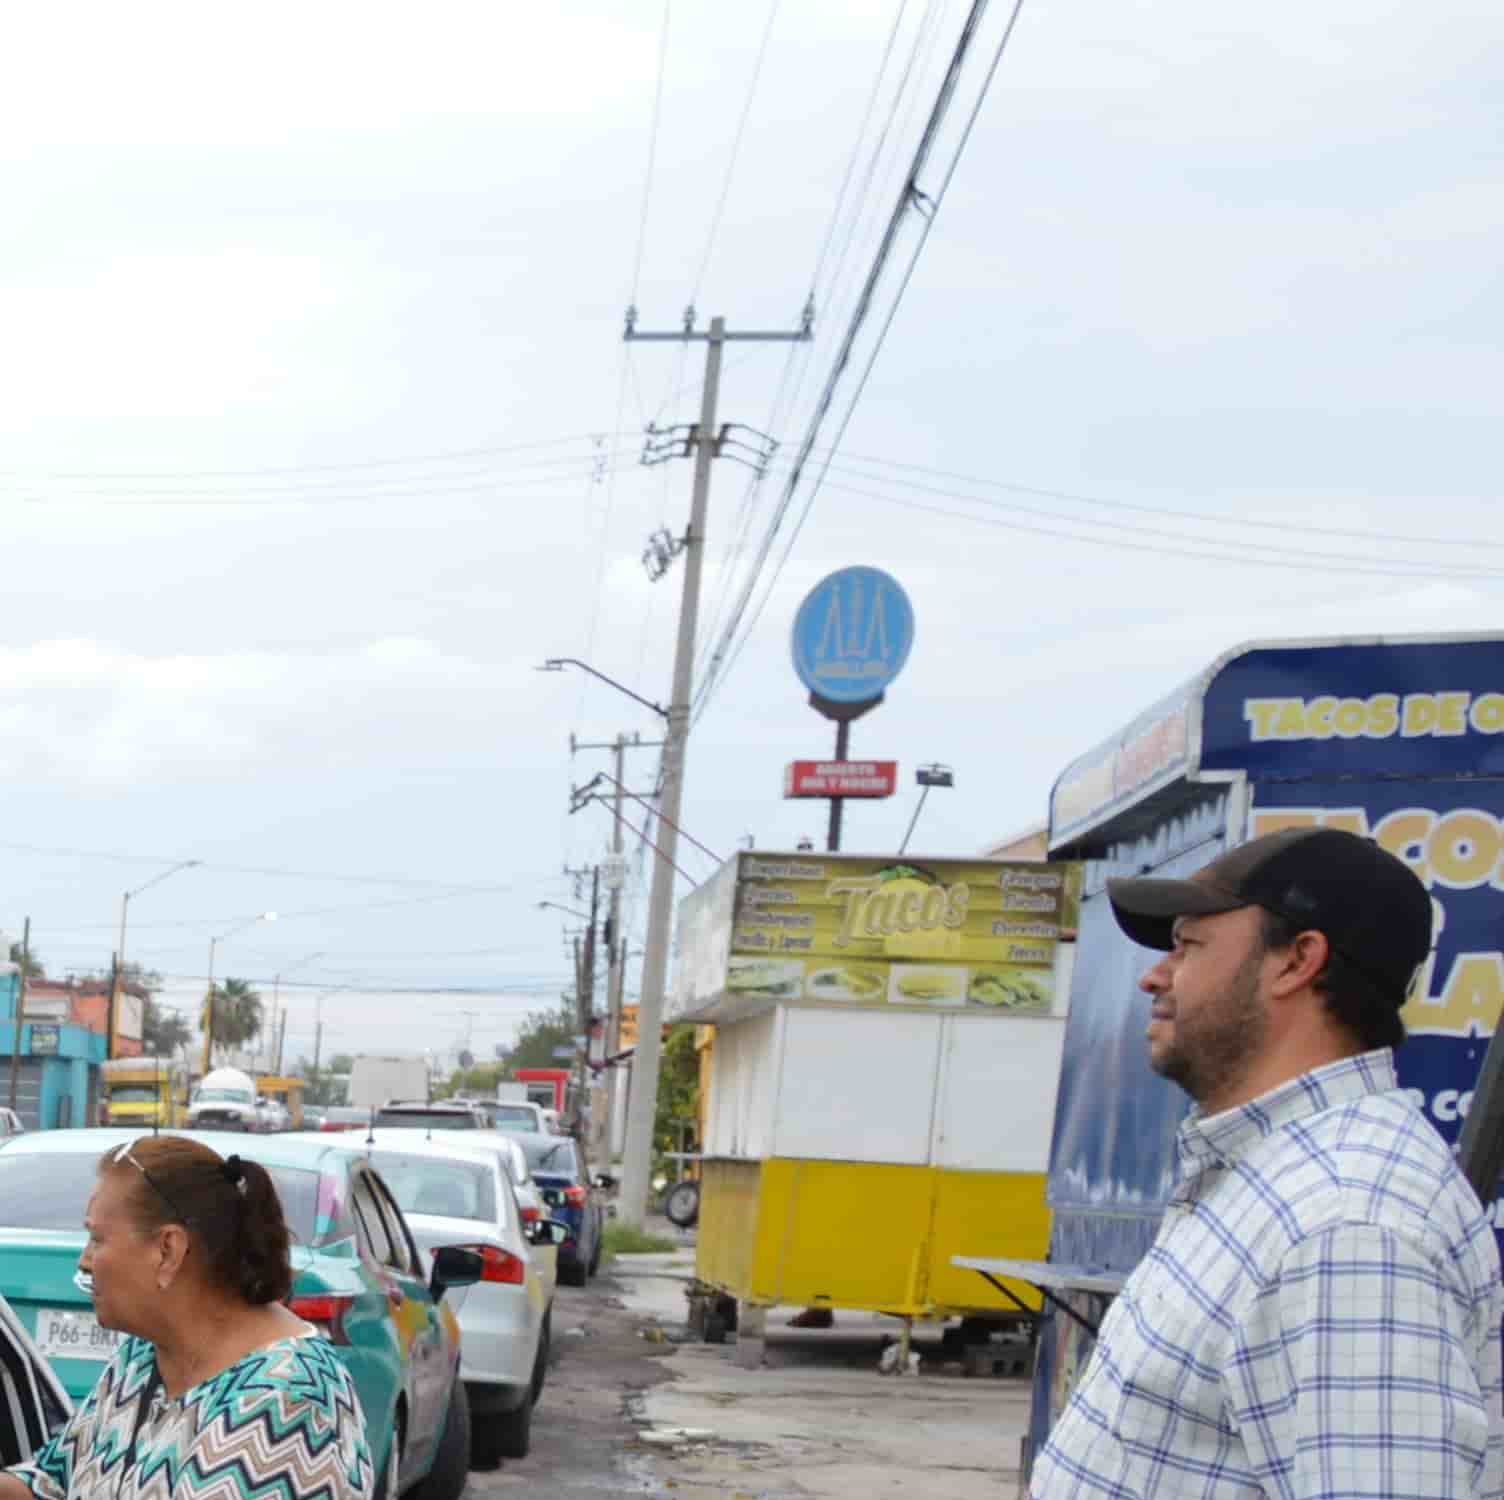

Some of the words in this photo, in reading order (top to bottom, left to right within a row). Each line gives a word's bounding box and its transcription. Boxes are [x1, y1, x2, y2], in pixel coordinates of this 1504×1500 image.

[1243, 694, 1401, 742] TACOS
[1400, 690, 1471, 738] DE
[826, 878, 970, 948] Tacos
